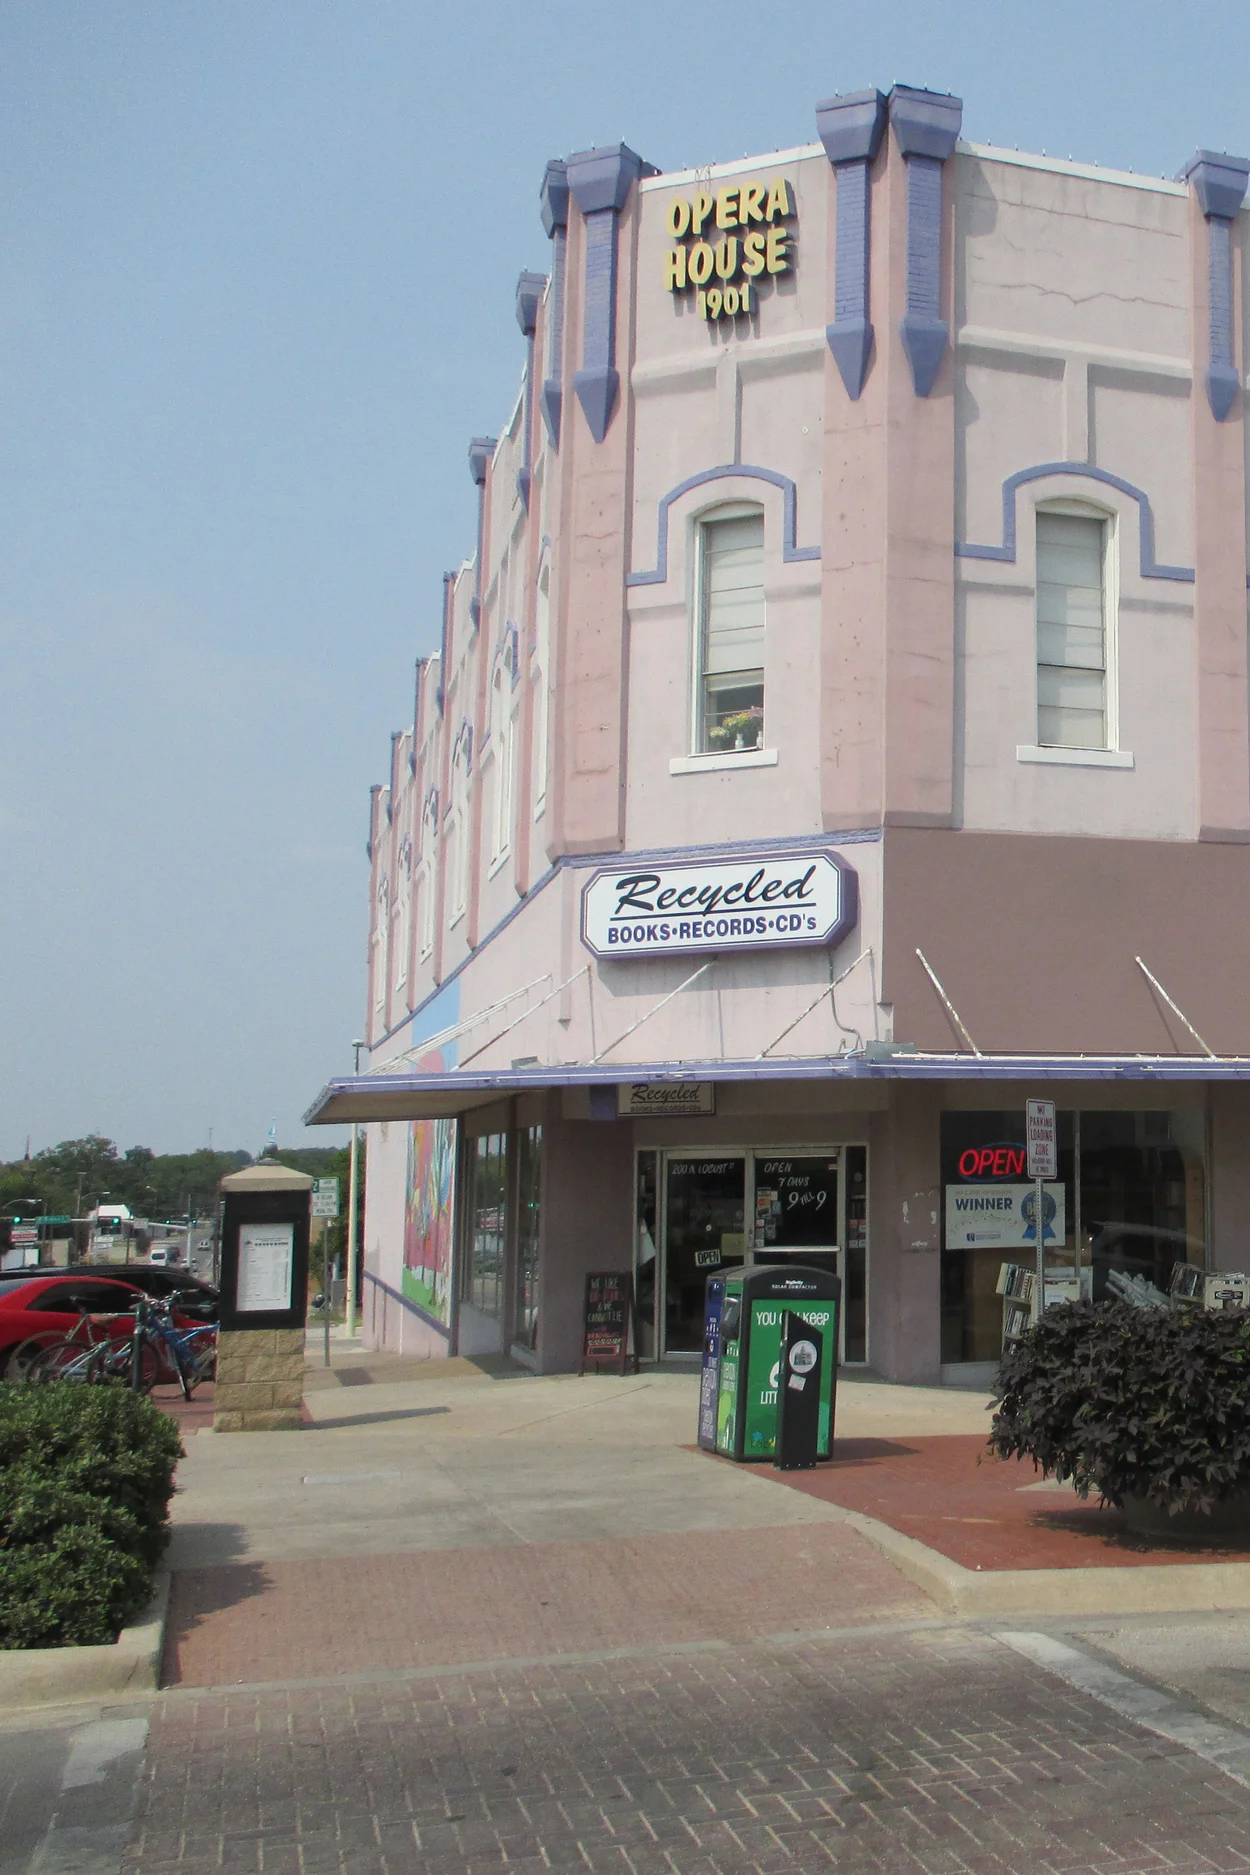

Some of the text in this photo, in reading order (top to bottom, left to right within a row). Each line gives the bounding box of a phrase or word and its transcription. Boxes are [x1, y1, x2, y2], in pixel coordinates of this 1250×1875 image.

[666, 178, 790, 238] OPERA
[664, 228, 787, 291] HOUSE
[699, 283, 751, 320] 1901
[614, 865, 817, 916] Recycled
[630, 1083, 700, 1104] Recycled
[1029, 1116, 1053, 1127] PARKING
[1030, 1129, 1053, 1141] LOADING
[1035, 1144, 1049, 1156] ZONE
[698, 1163, 728, 1174] LOCUST
[764, 1162, 793, 1173] OPEN
[959, 1149, 1026, 1176] OPEN
[778, 1177, 810, 1187] 7 DAYS
[787, 1191, 799, 1210] 9
[800, 1192, 816, 1205] TILL
[815, 1190, 827, 1211] 9
[955, 1198, 1013, 1210] WINNER
[697, 1252, 719, 1264] OPEN
[756, 1311, 776, 1325] YOU
[760, 1390, 778, 1404] LITT
